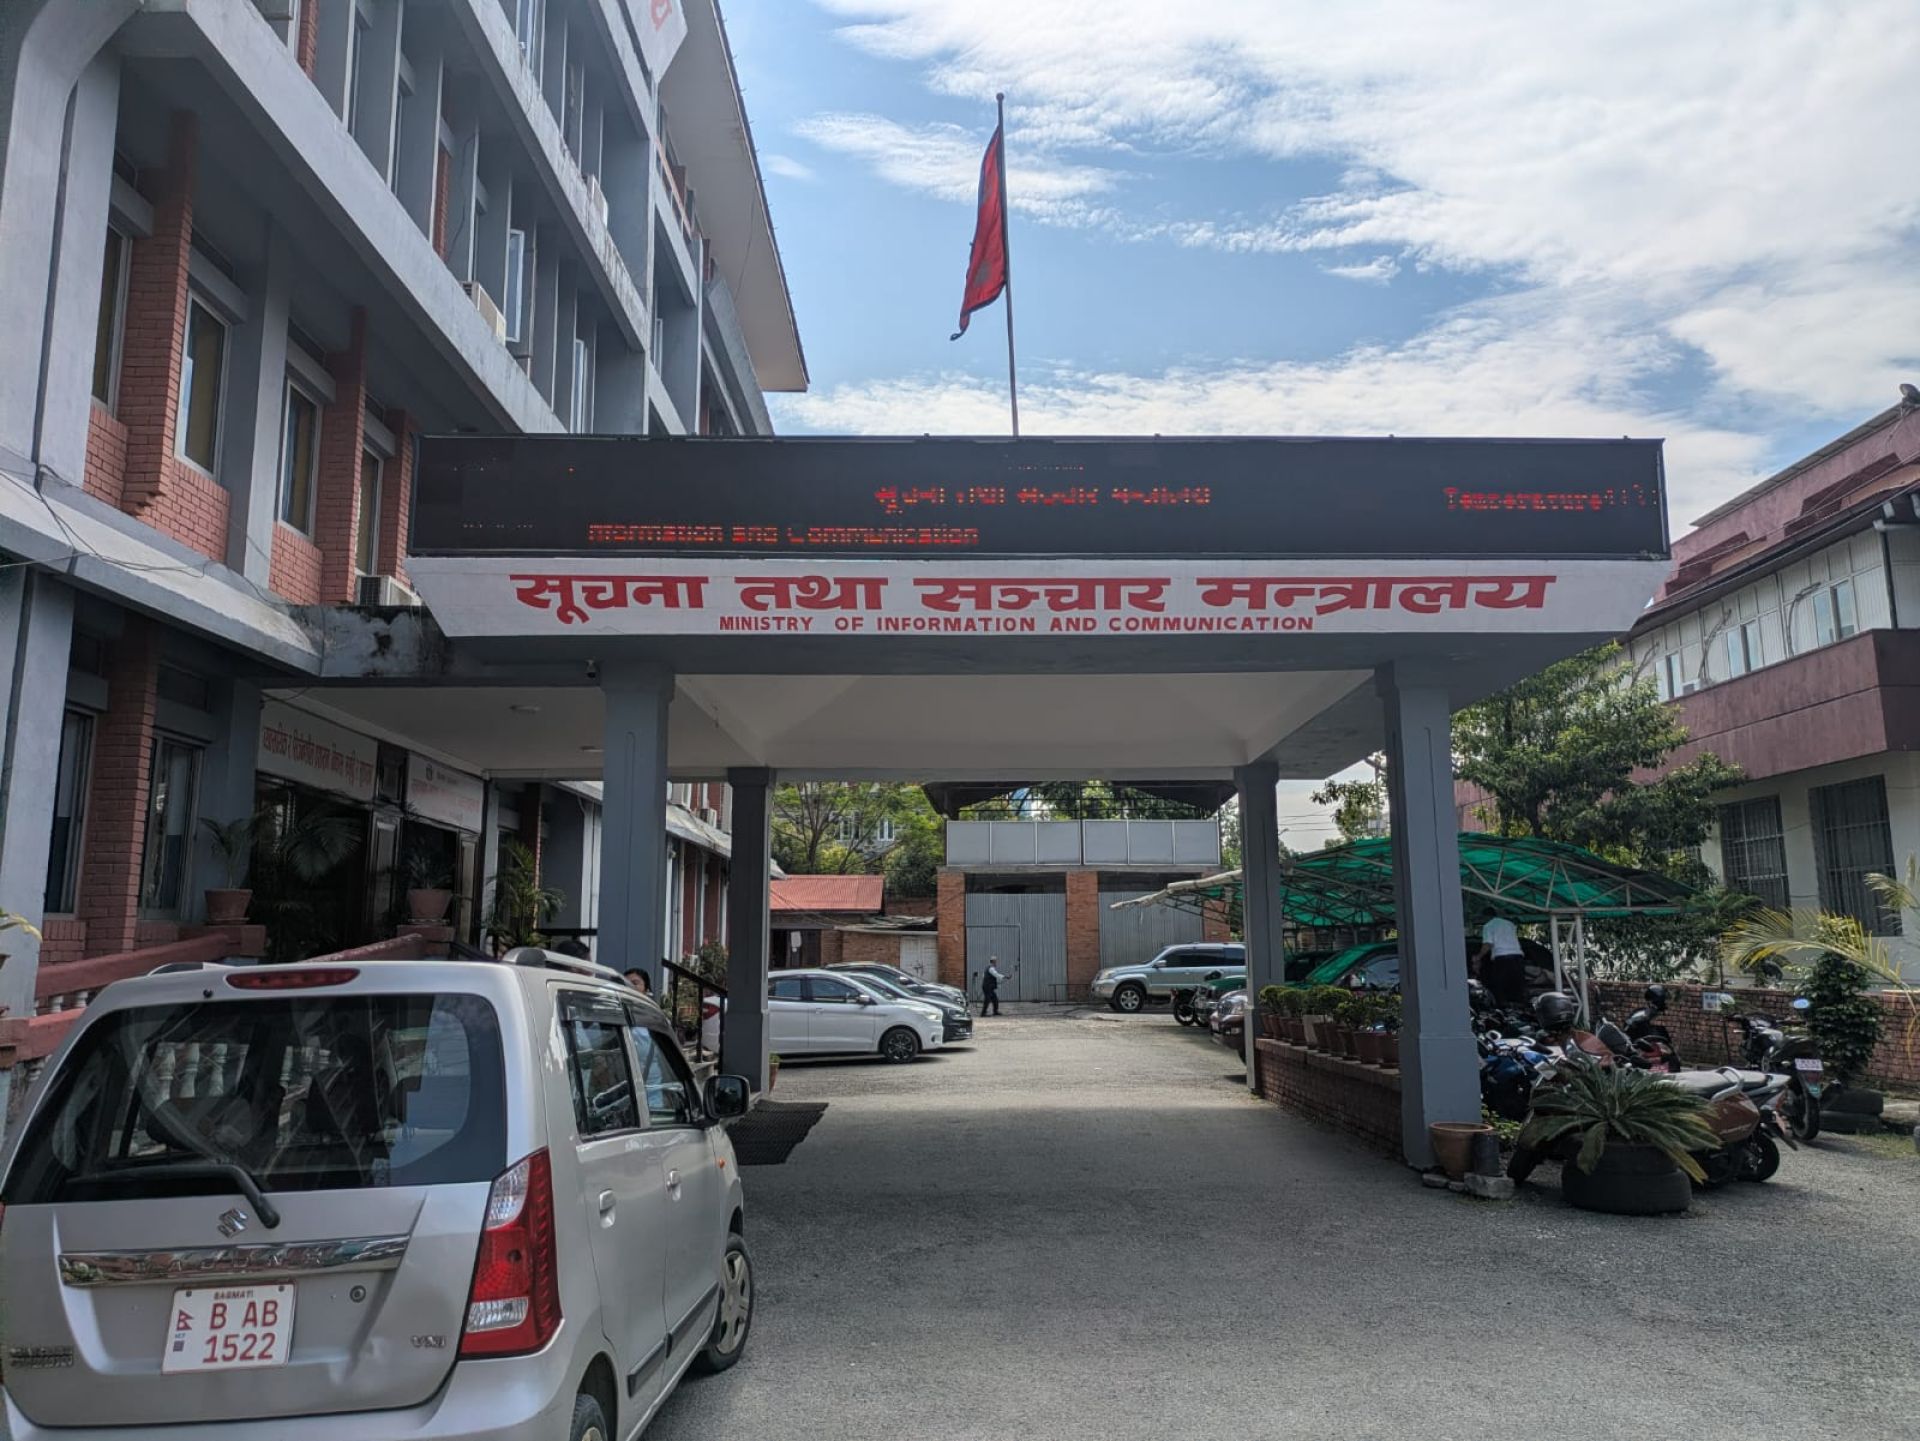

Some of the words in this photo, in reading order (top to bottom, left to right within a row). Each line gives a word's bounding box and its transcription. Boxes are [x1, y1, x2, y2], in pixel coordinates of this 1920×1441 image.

[509, 574, 709, 624] सूचना
[734, 575, 889, 612] तथा
[912, 577, 1171, 613] सञ्चार
[1196, 575, 1557, 616] मन्त्रालय
[719, 615, 812, 632] MINISTRY
[835, 616, 864, 631] OF
[877, 616, 1036, 631] INFORMATION
[1050, 616, 1097, 631] AND
[1109, 616, 1313, 631] COMMUNICATION
[209, 1302, 228, 1330] B
[242, 1299, 279, 1329] AB
[202, 1332, 276, 1364] 1522
